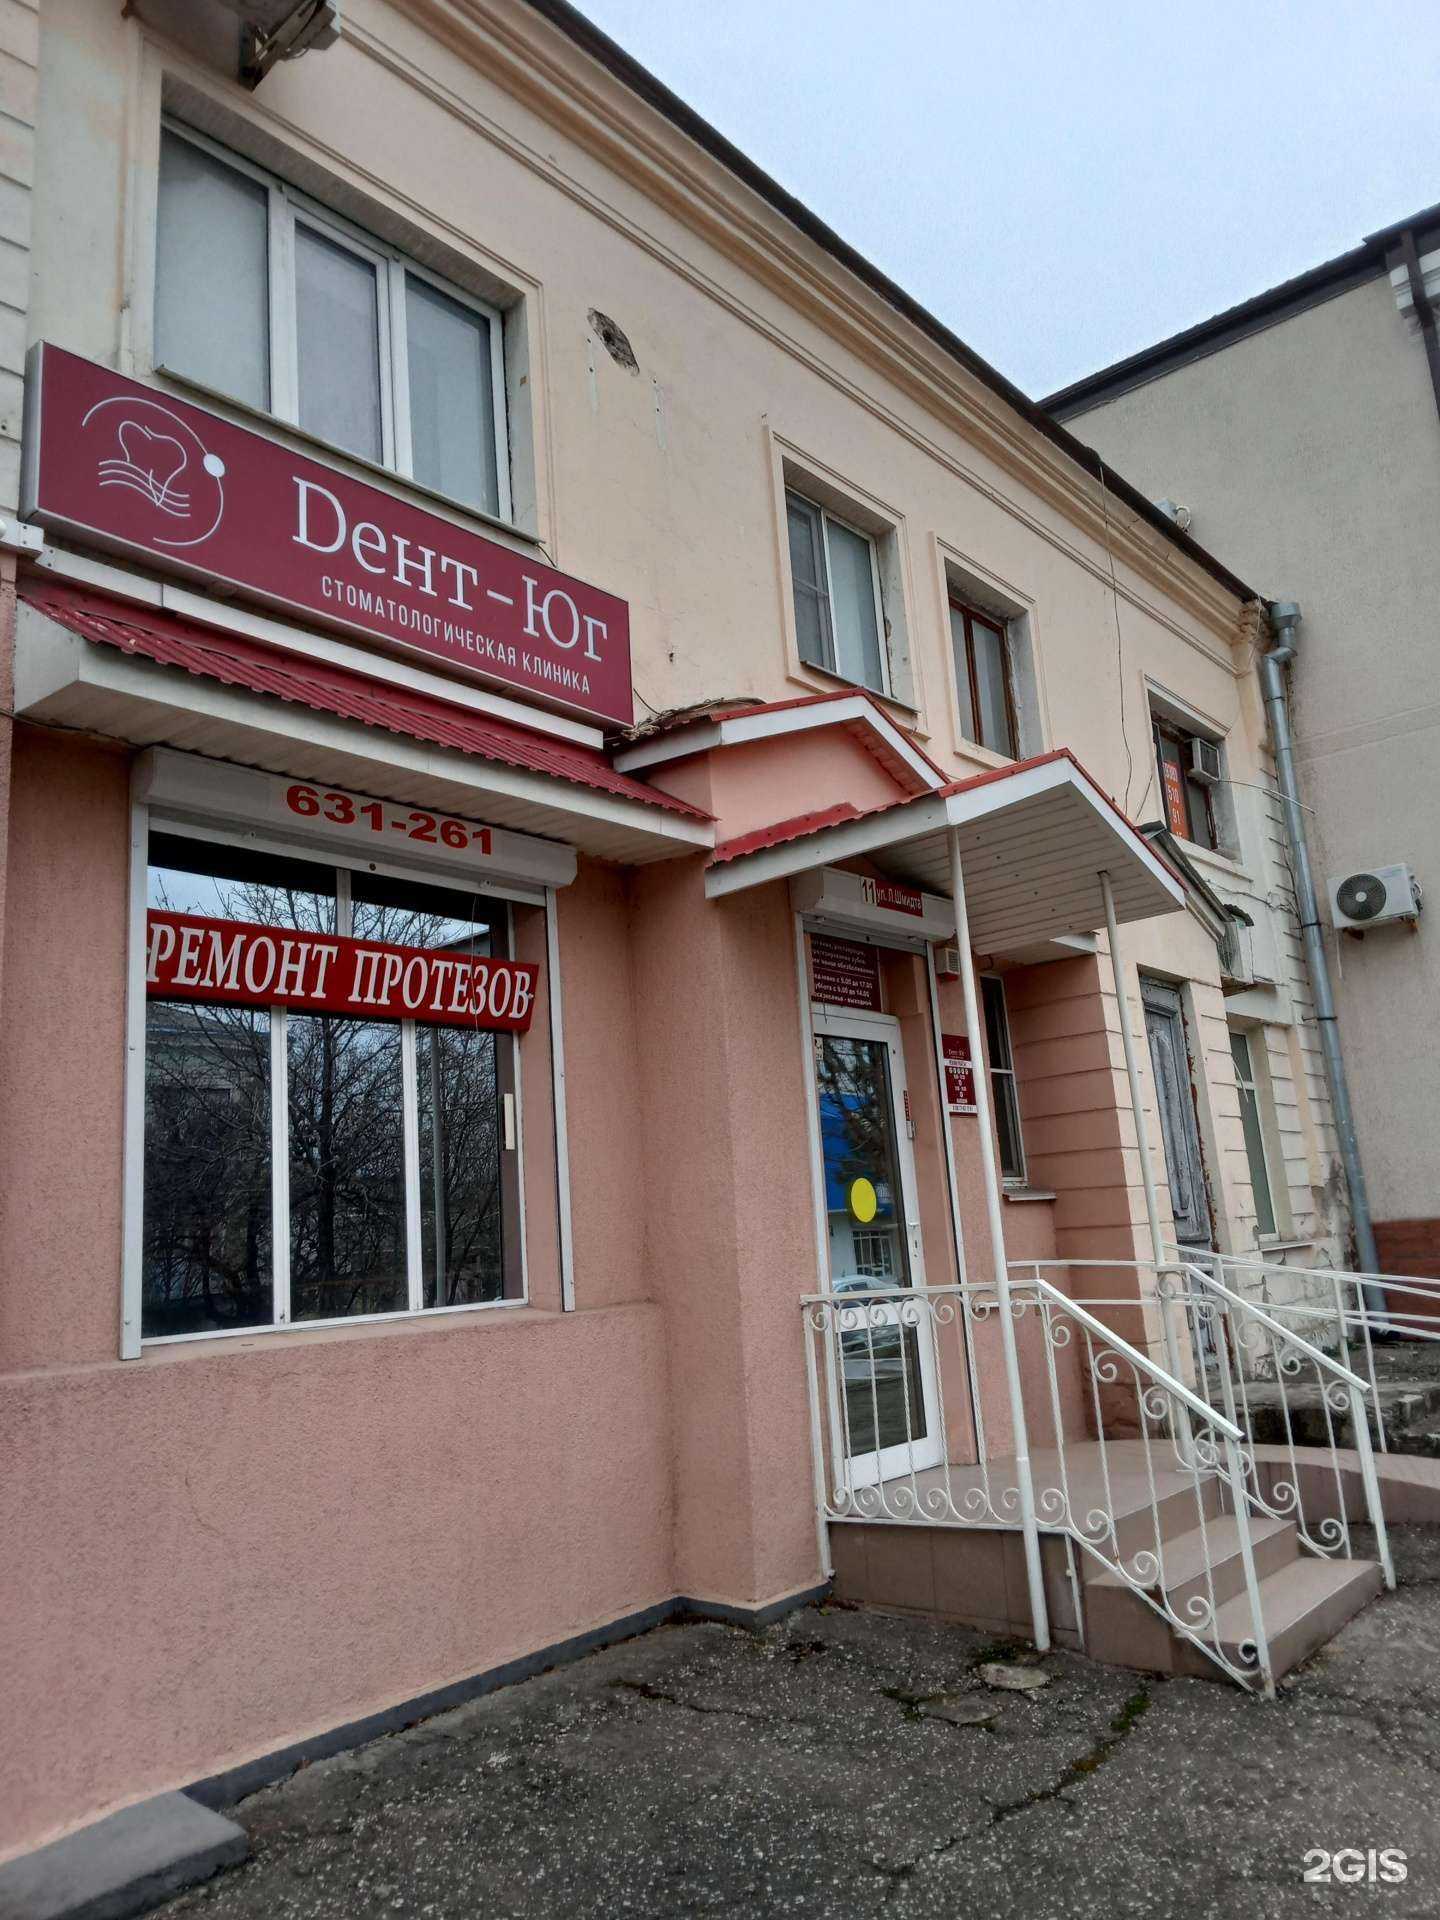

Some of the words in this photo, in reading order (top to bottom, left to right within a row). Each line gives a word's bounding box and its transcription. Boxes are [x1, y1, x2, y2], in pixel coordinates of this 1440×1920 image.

[321, 575, 517, 667] СТОМАТОЛОГИЧЕСКАЯ
[522, 653, 591, 694] КЛИНИКА
[286, 784, 492, 856] 631-261
[862, 879, 875, 904] 11
[147, 922, 338, 999] РЕМОНТ
[348, 948, 533, 1020] ПРОТЕЗОВ
